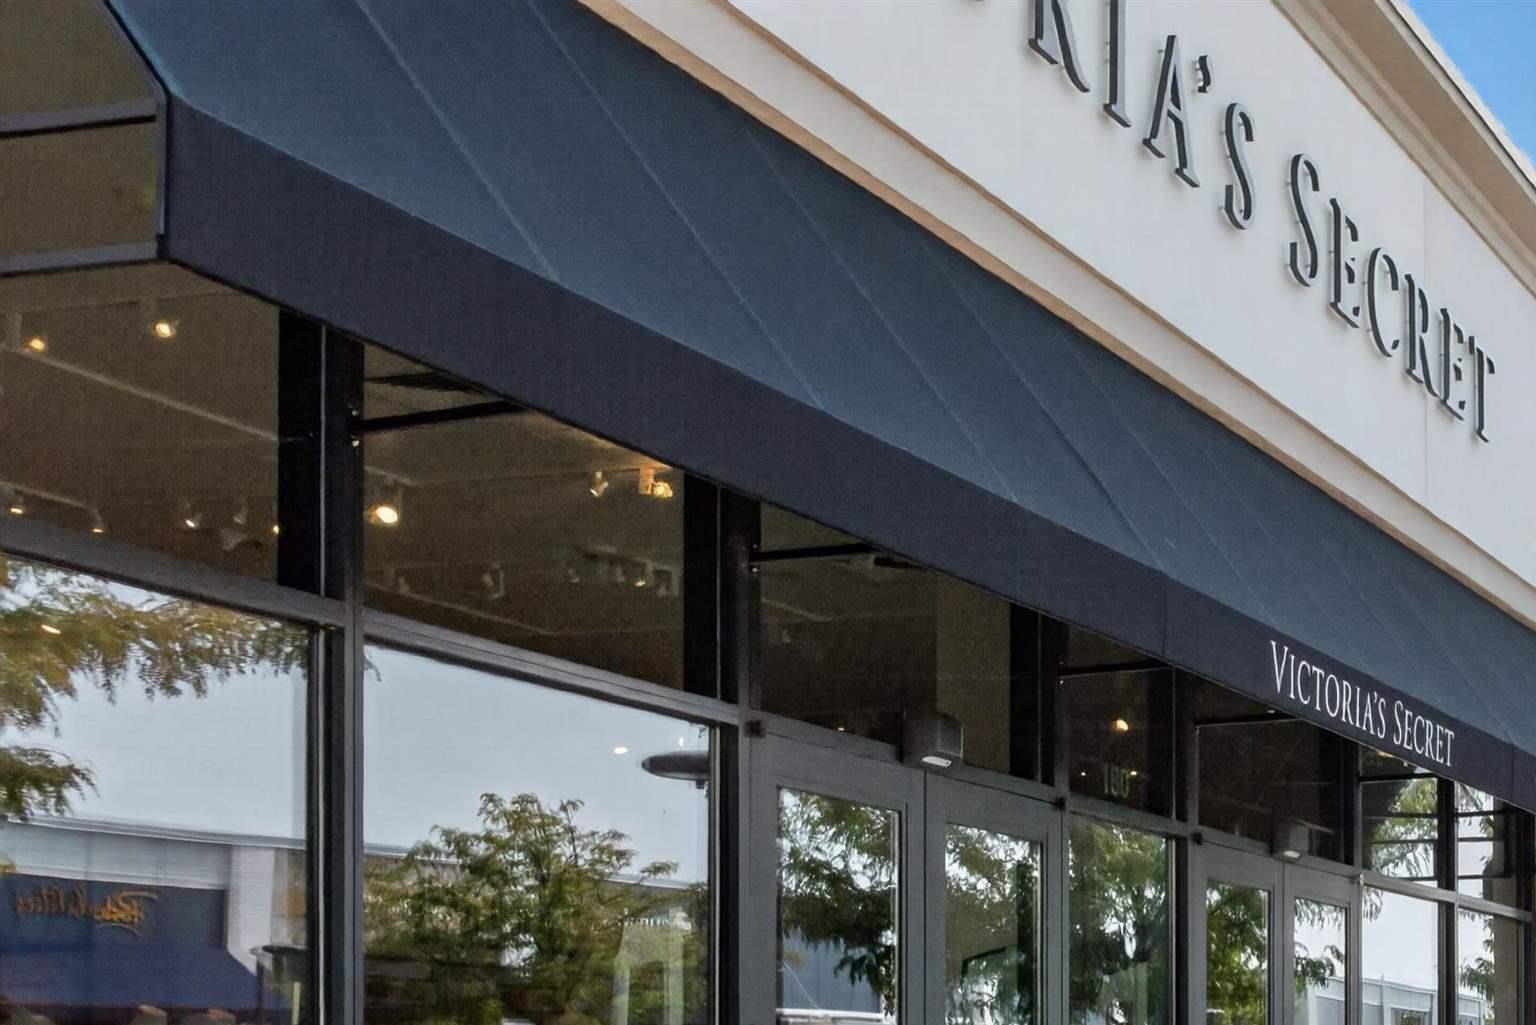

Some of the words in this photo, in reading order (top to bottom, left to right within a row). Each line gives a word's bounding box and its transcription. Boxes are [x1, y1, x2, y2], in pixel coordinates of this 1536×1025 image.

[1285, 153, 1495, 443] SECRET
[1270, 640, 1386, 740] VICTORIA'S
[1393, 700, 1456, 767] SECRET
